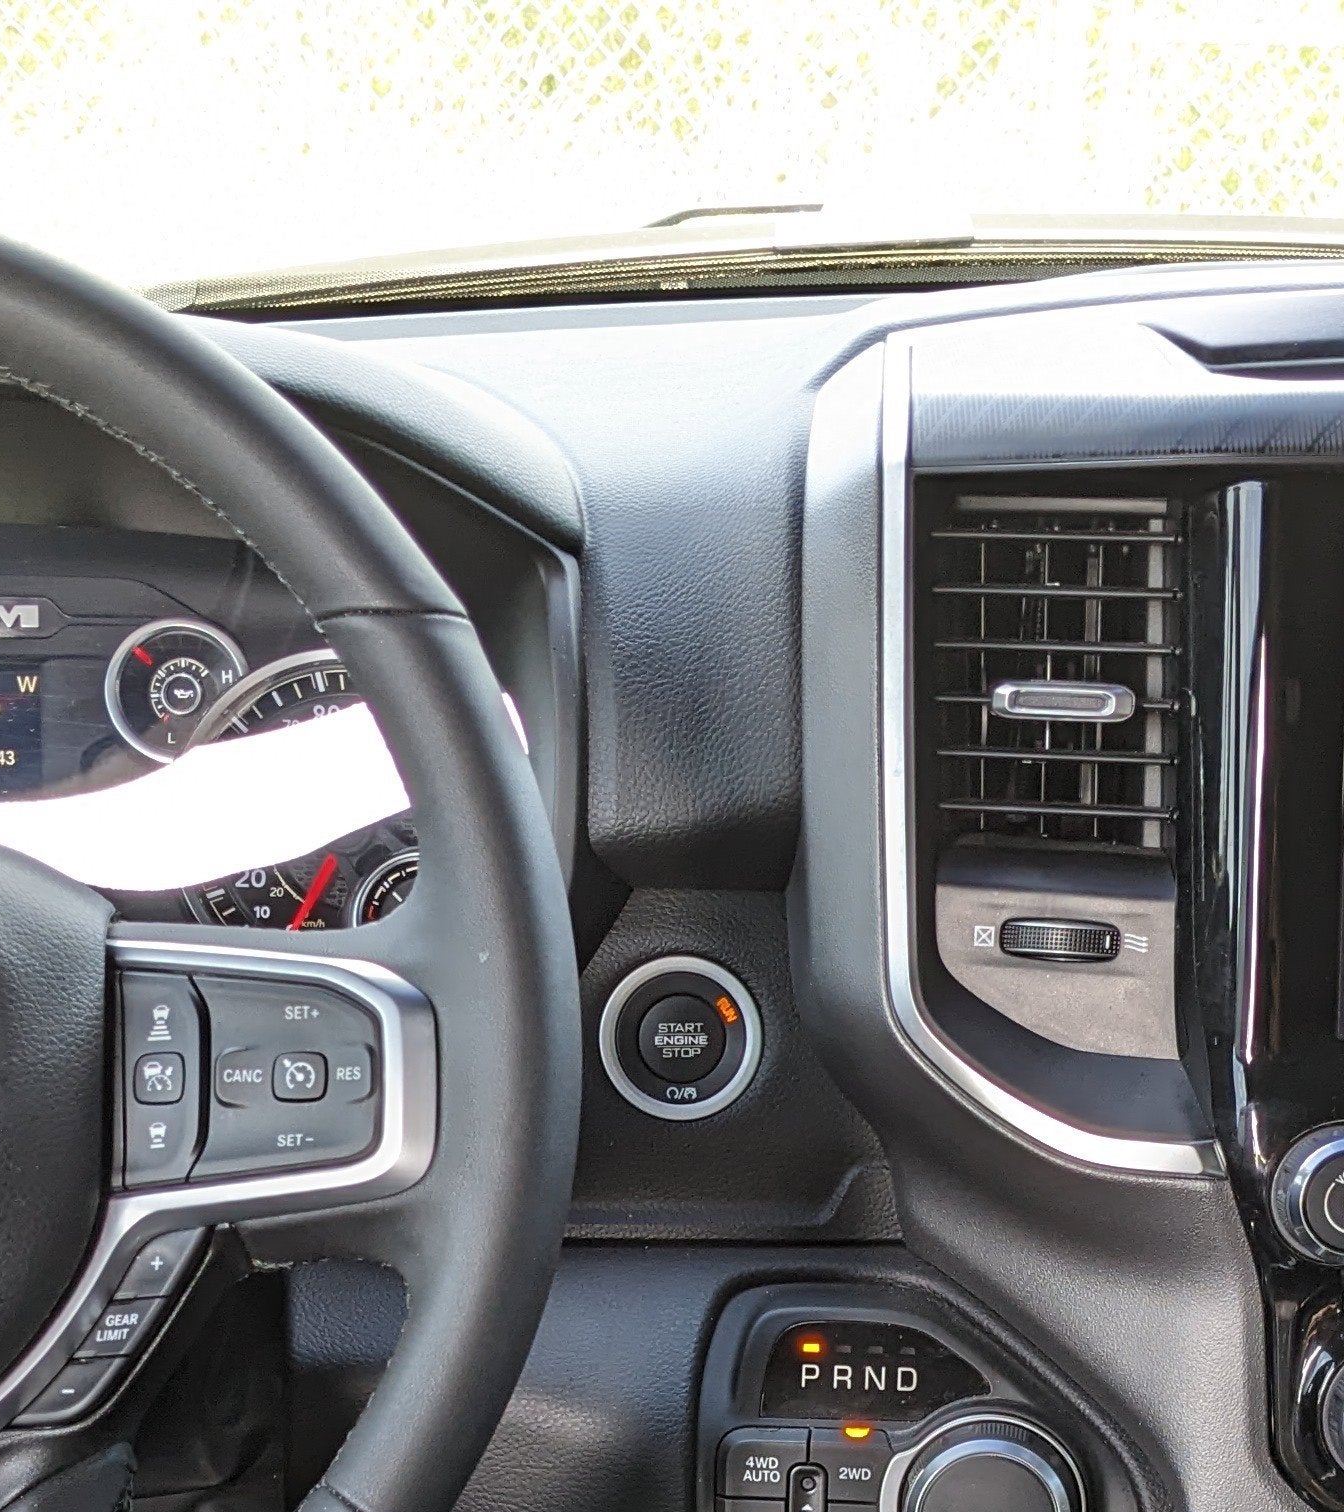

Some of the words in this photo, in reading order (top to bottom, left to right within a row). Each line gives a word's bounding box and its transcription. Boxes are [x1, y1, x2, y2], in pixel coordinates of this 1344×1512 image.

[222, 670, 233, 684] H
[17, 676, 37, 693] W
[167, 733, 176, 744] L
[234, 869, 267, 888] 20
[269, 887, 284, 898] 20
[254, 906, 270, 919] 10
[301, 919, 326, 929] km/h
[716, 997, 737, 1022] RUN
[658, 1023, 704, 1033] START
[654, 1035, 709, 1046] ENGINE
[662, 1048, 701, 1058] STOP
[223, 1069, 263, 1085] CANC
[336, 1066, 361, 1082] RES
[105, 1313, 139, 1327] GEAR
[96, 1328, 130, 1342] LIMIT
[745, 1457, 778, 1471] 4WD
[743, 1469, 781, 1484] AUTO
[838, 1467, 871, 1482] 2WD
